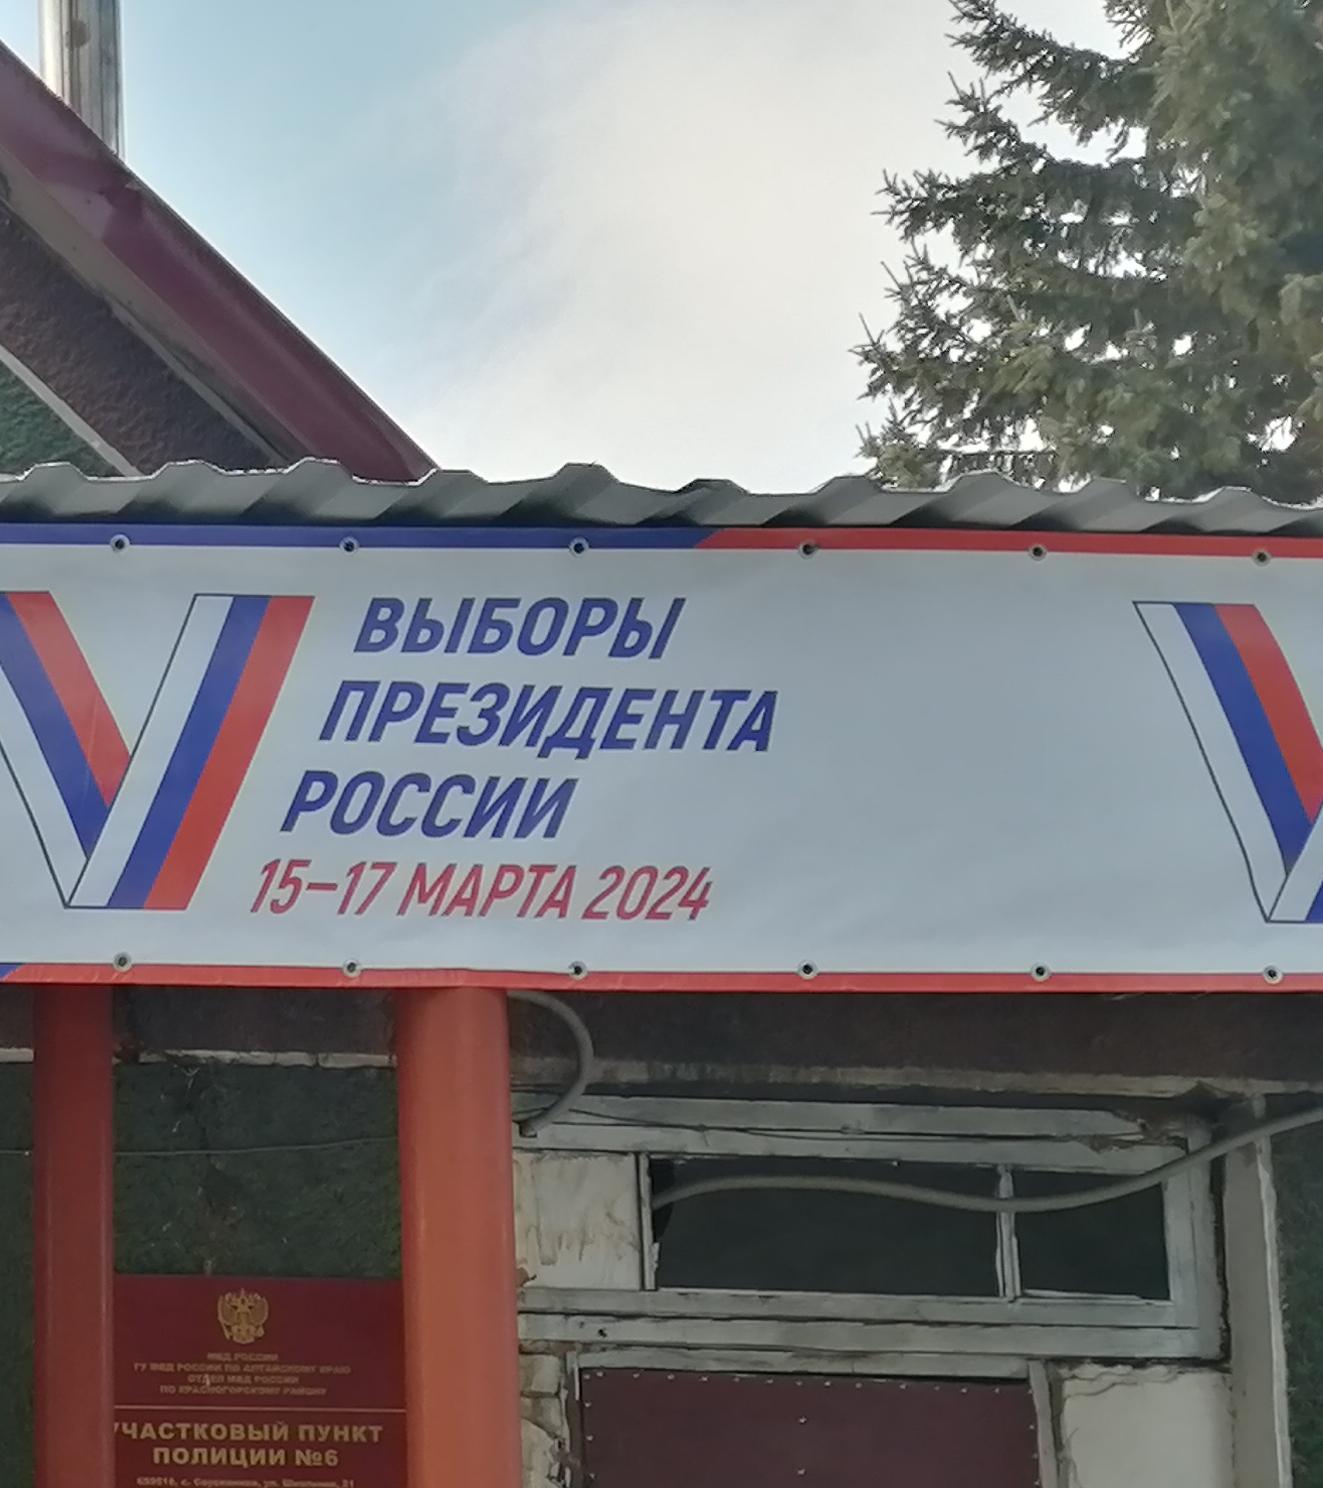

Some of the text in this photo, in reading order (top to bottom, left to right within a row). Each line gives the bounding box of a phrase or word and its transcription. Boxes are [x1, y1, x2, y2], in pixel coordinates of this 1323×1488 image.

[354, 598, 686, 659] ВЫБОРЫ
[319, 681, 778, 759] ПРЕЗИДЕНТА
[280, 770, 578, 838] РОССИИ
[399, 861, 575, 921] МАРТА
[583, 865, 713, 922] 2024
[152, 1447, 339, 1468] ПОЛИЦИИ №6
[298, 1424, 383, 1443] ПУНКТ
